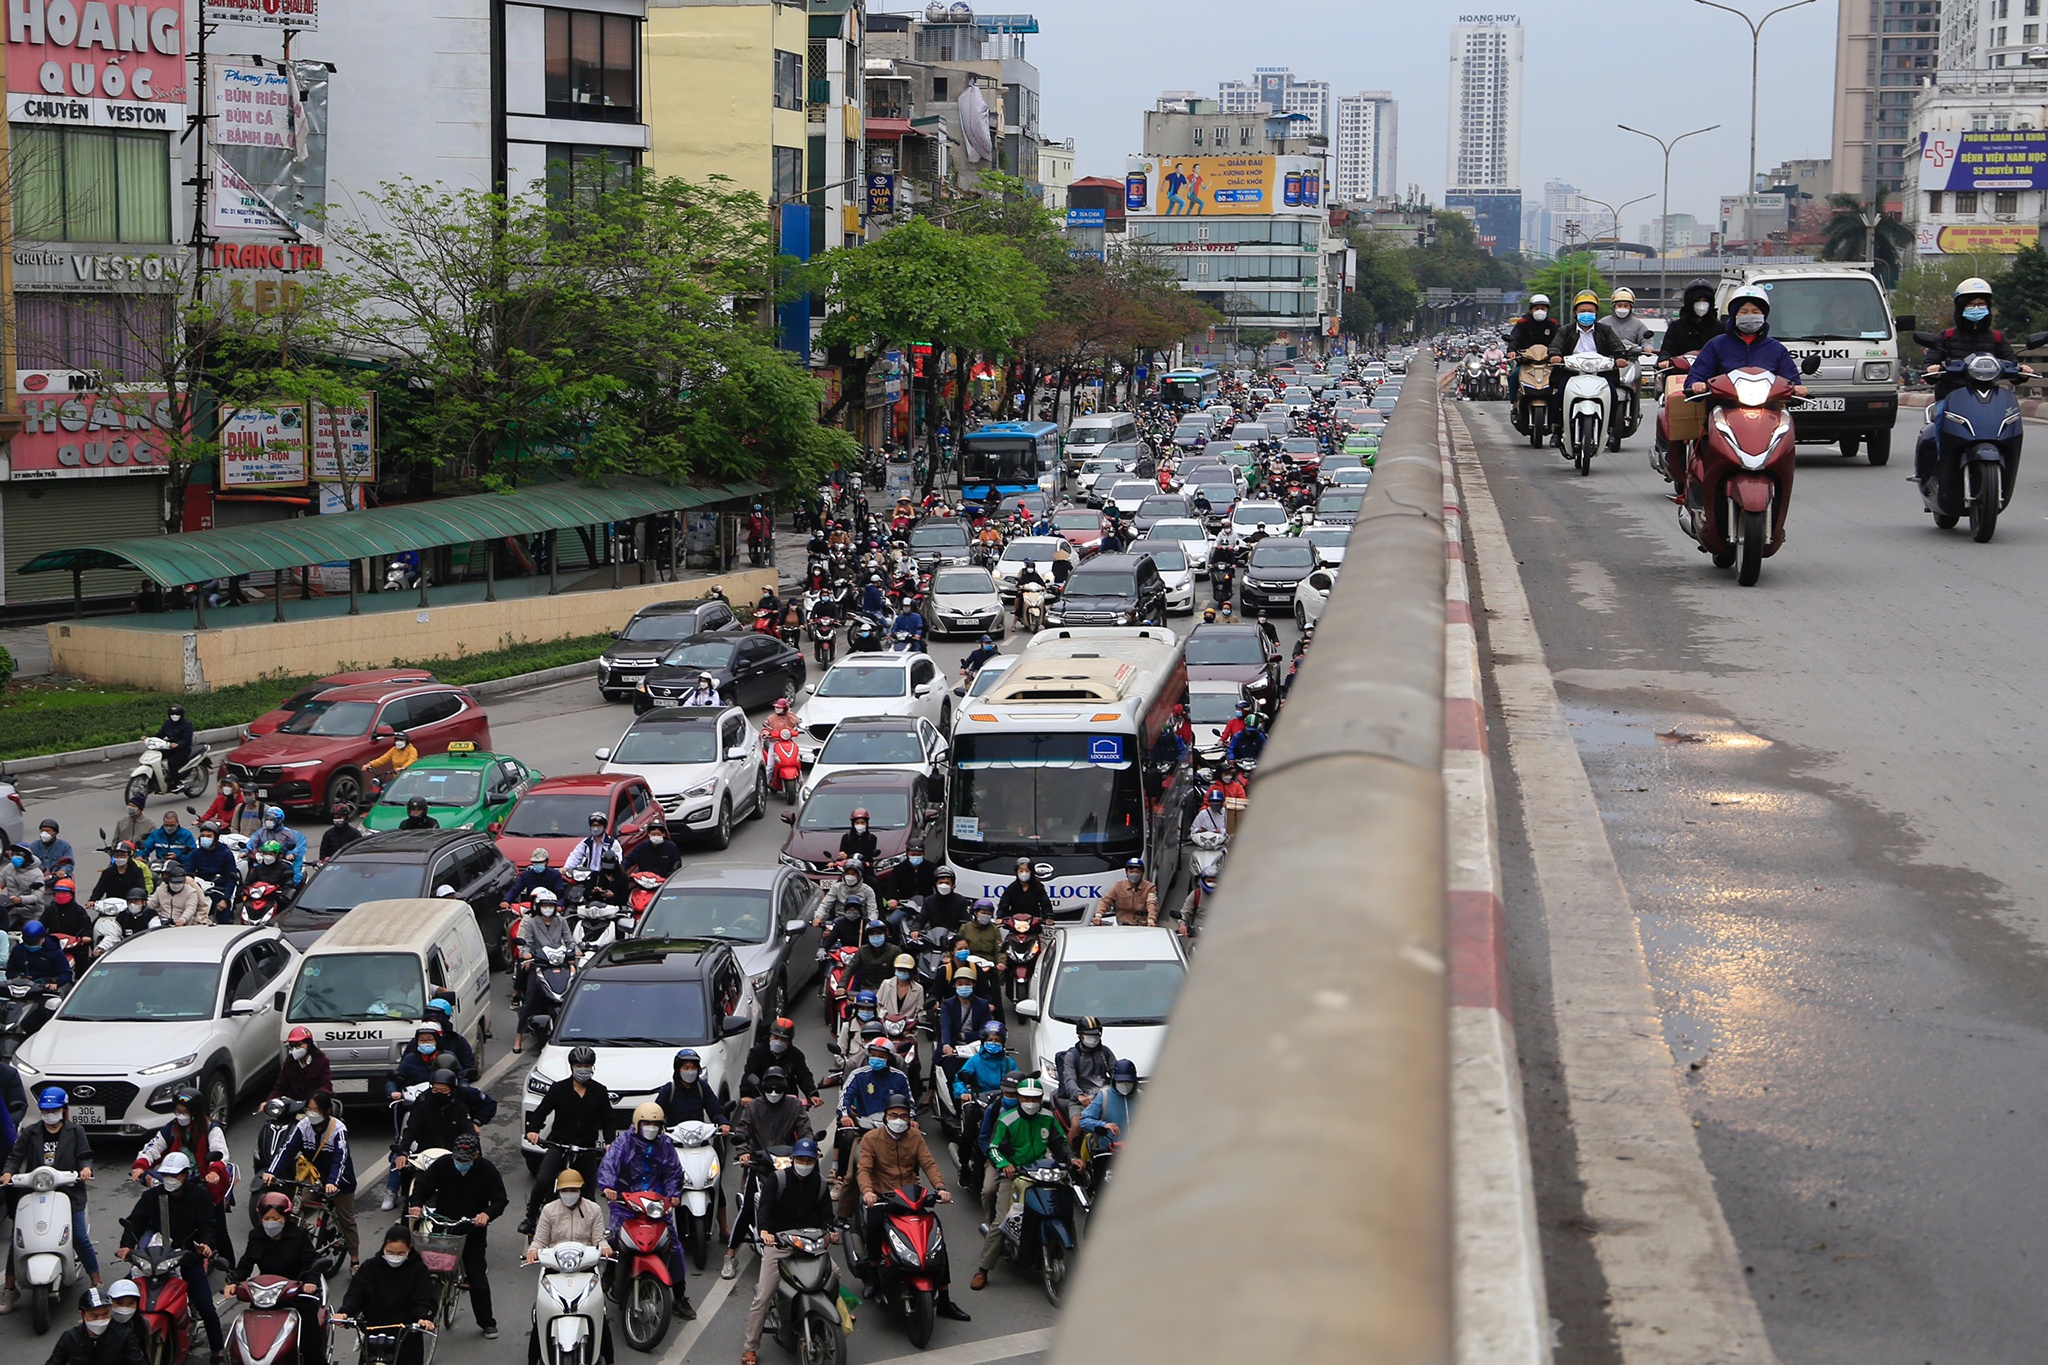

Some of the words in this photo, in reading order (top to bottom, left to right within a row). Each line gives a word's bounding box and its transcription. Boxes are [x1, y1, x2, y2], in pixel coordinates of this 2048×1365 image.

[40, 55, 153, 99] QUỐC
[225, 87, 251, 103] BÚN
[256, 91, 287, 106] RIÊU
[24, 100, 88, 119] CHUYÊN
[107, 105, 166, 123] VESTON
[226, 108, 252, 123] BÚN
[256, 110, 274, 125] CÁ
[227, 128, 261, 144] BÁNH
[2026, 133, 2046, 141] KHOA
[1961, 152, 1983, 163] BỆNH
[1985, 152, 2004, 163] VIỆN
[2007, 153, 2026, 162] NAM
[2028, 153, 2047, 163] HỌC
[1973, 167, 1983, 175] 52
[1129, 184, 1144, 195] JEX
[1287, 182, 1301, 193] JEX
[873, 197, 888, 205] VIP
[1200, 243, 1235, 252] COFFEE
[214, 244, 284, 269] TRANG
[71, 253, 186, 281] VESTON
[230, 279, 303, 315] LED
[1789, 349, 1849, 359] SUZUKI
[58, 434, 153, 466] QUỐC
[325, 1030, 382, 1041] SUZUKI
[79, 1107, 95, 1115] 30G
[72, 1116, 102, 1124] 890.64
